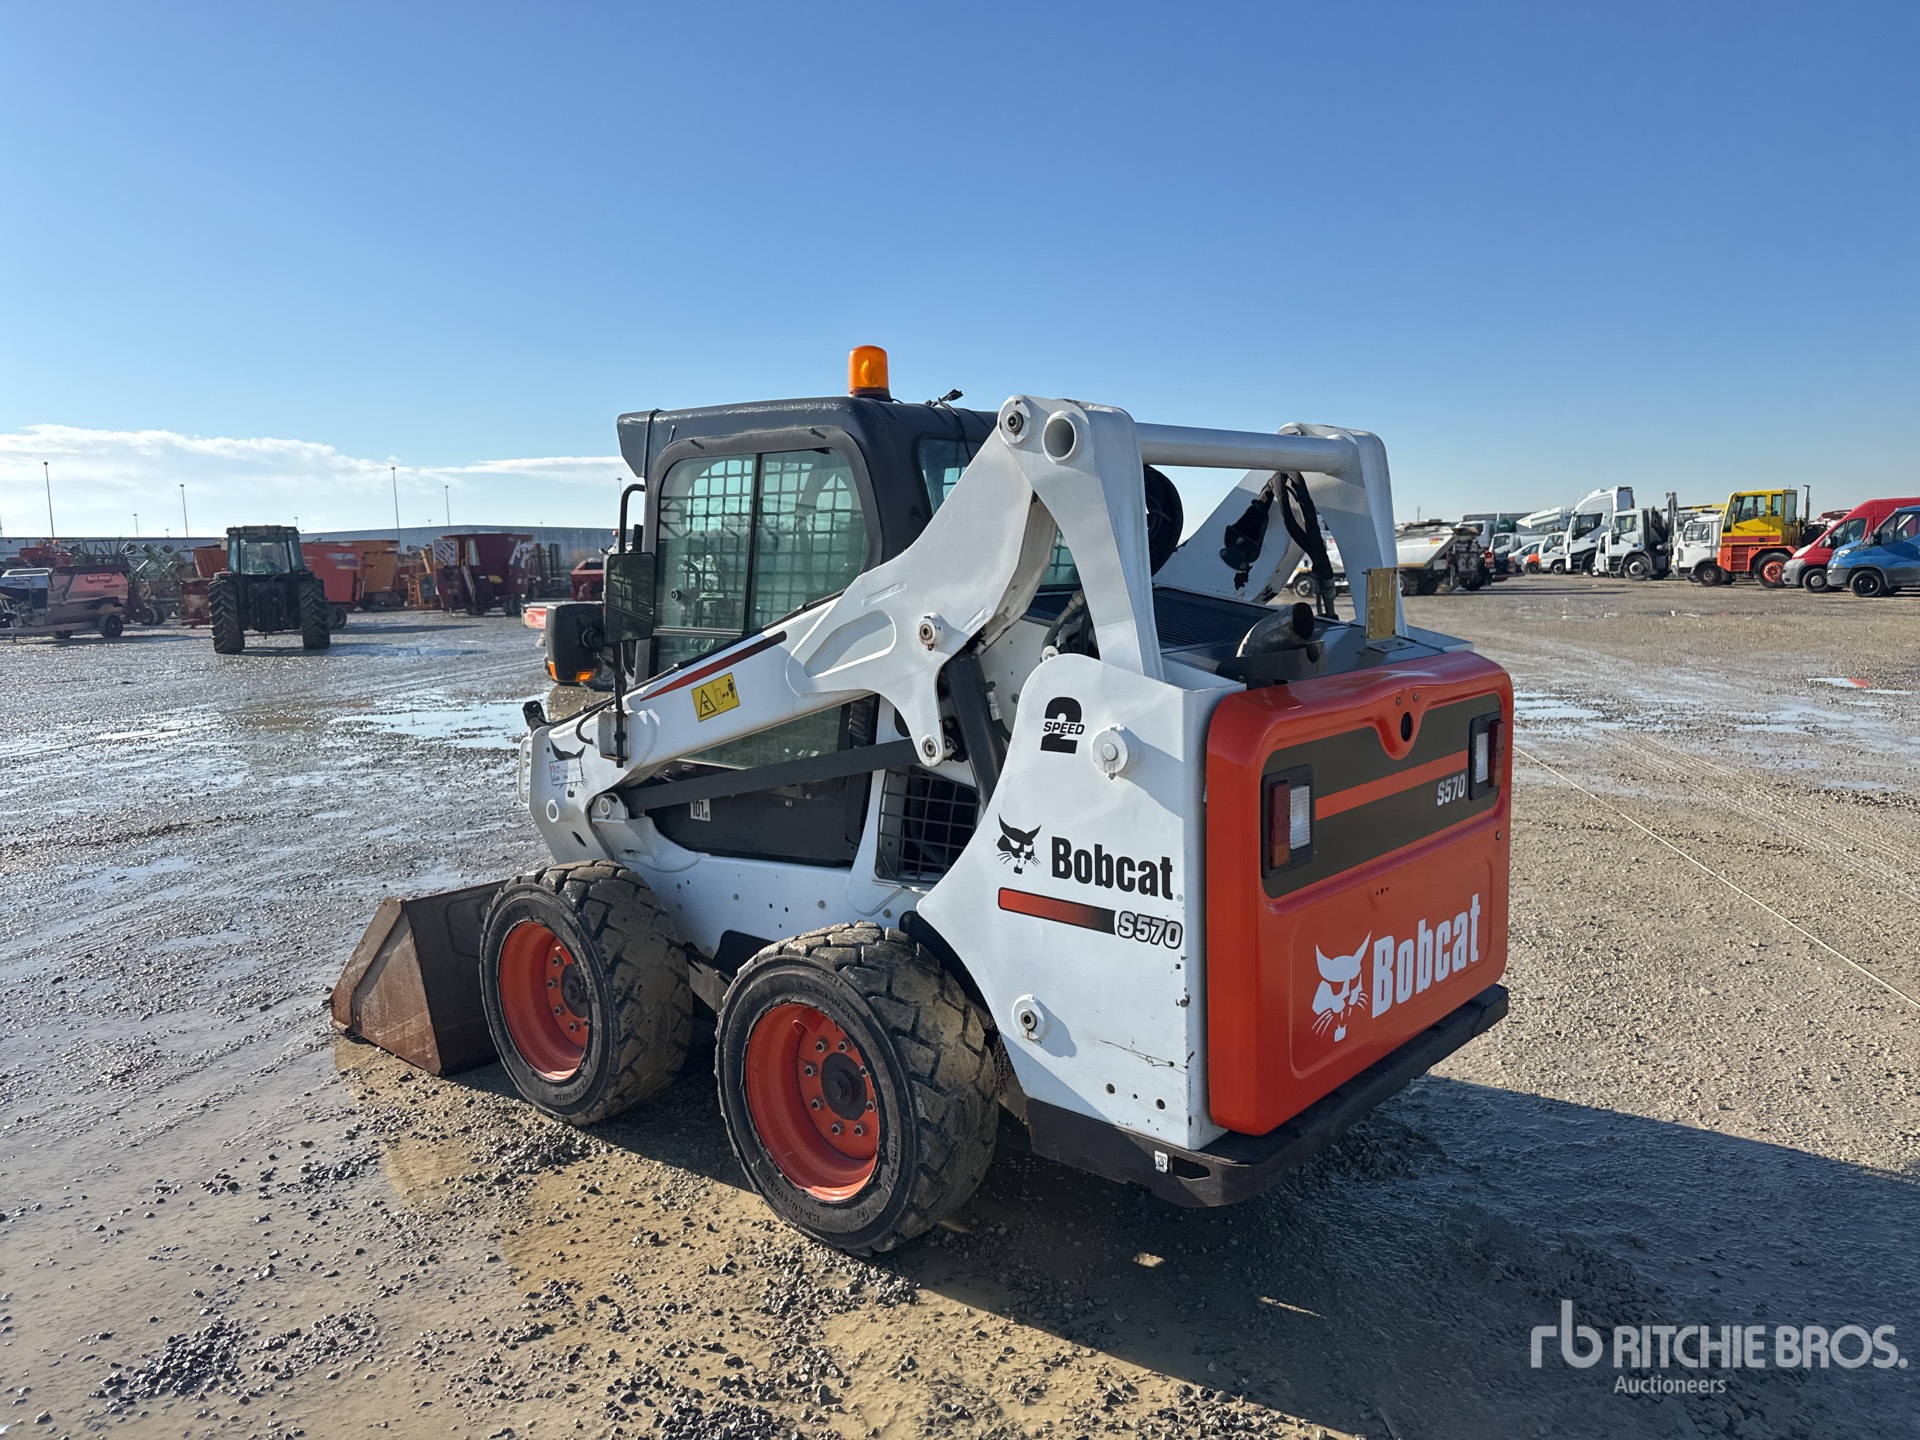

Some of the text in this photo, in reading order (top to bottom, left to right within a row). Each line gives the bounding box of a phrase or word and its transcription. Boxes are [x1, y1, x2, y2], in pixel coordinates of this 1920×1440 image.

[1040, 696, 1082, 754] 2
[1043, 720, 1086, 735] SPEED
[691, 800, 704, 818] 101
[1436, 773, 1466, 807] S570
[1051, 836, 1173, 900] Bobcat
[1117, 910, 1183, 950] S570
[1371, 893, 1481, 1018] Bobcat
